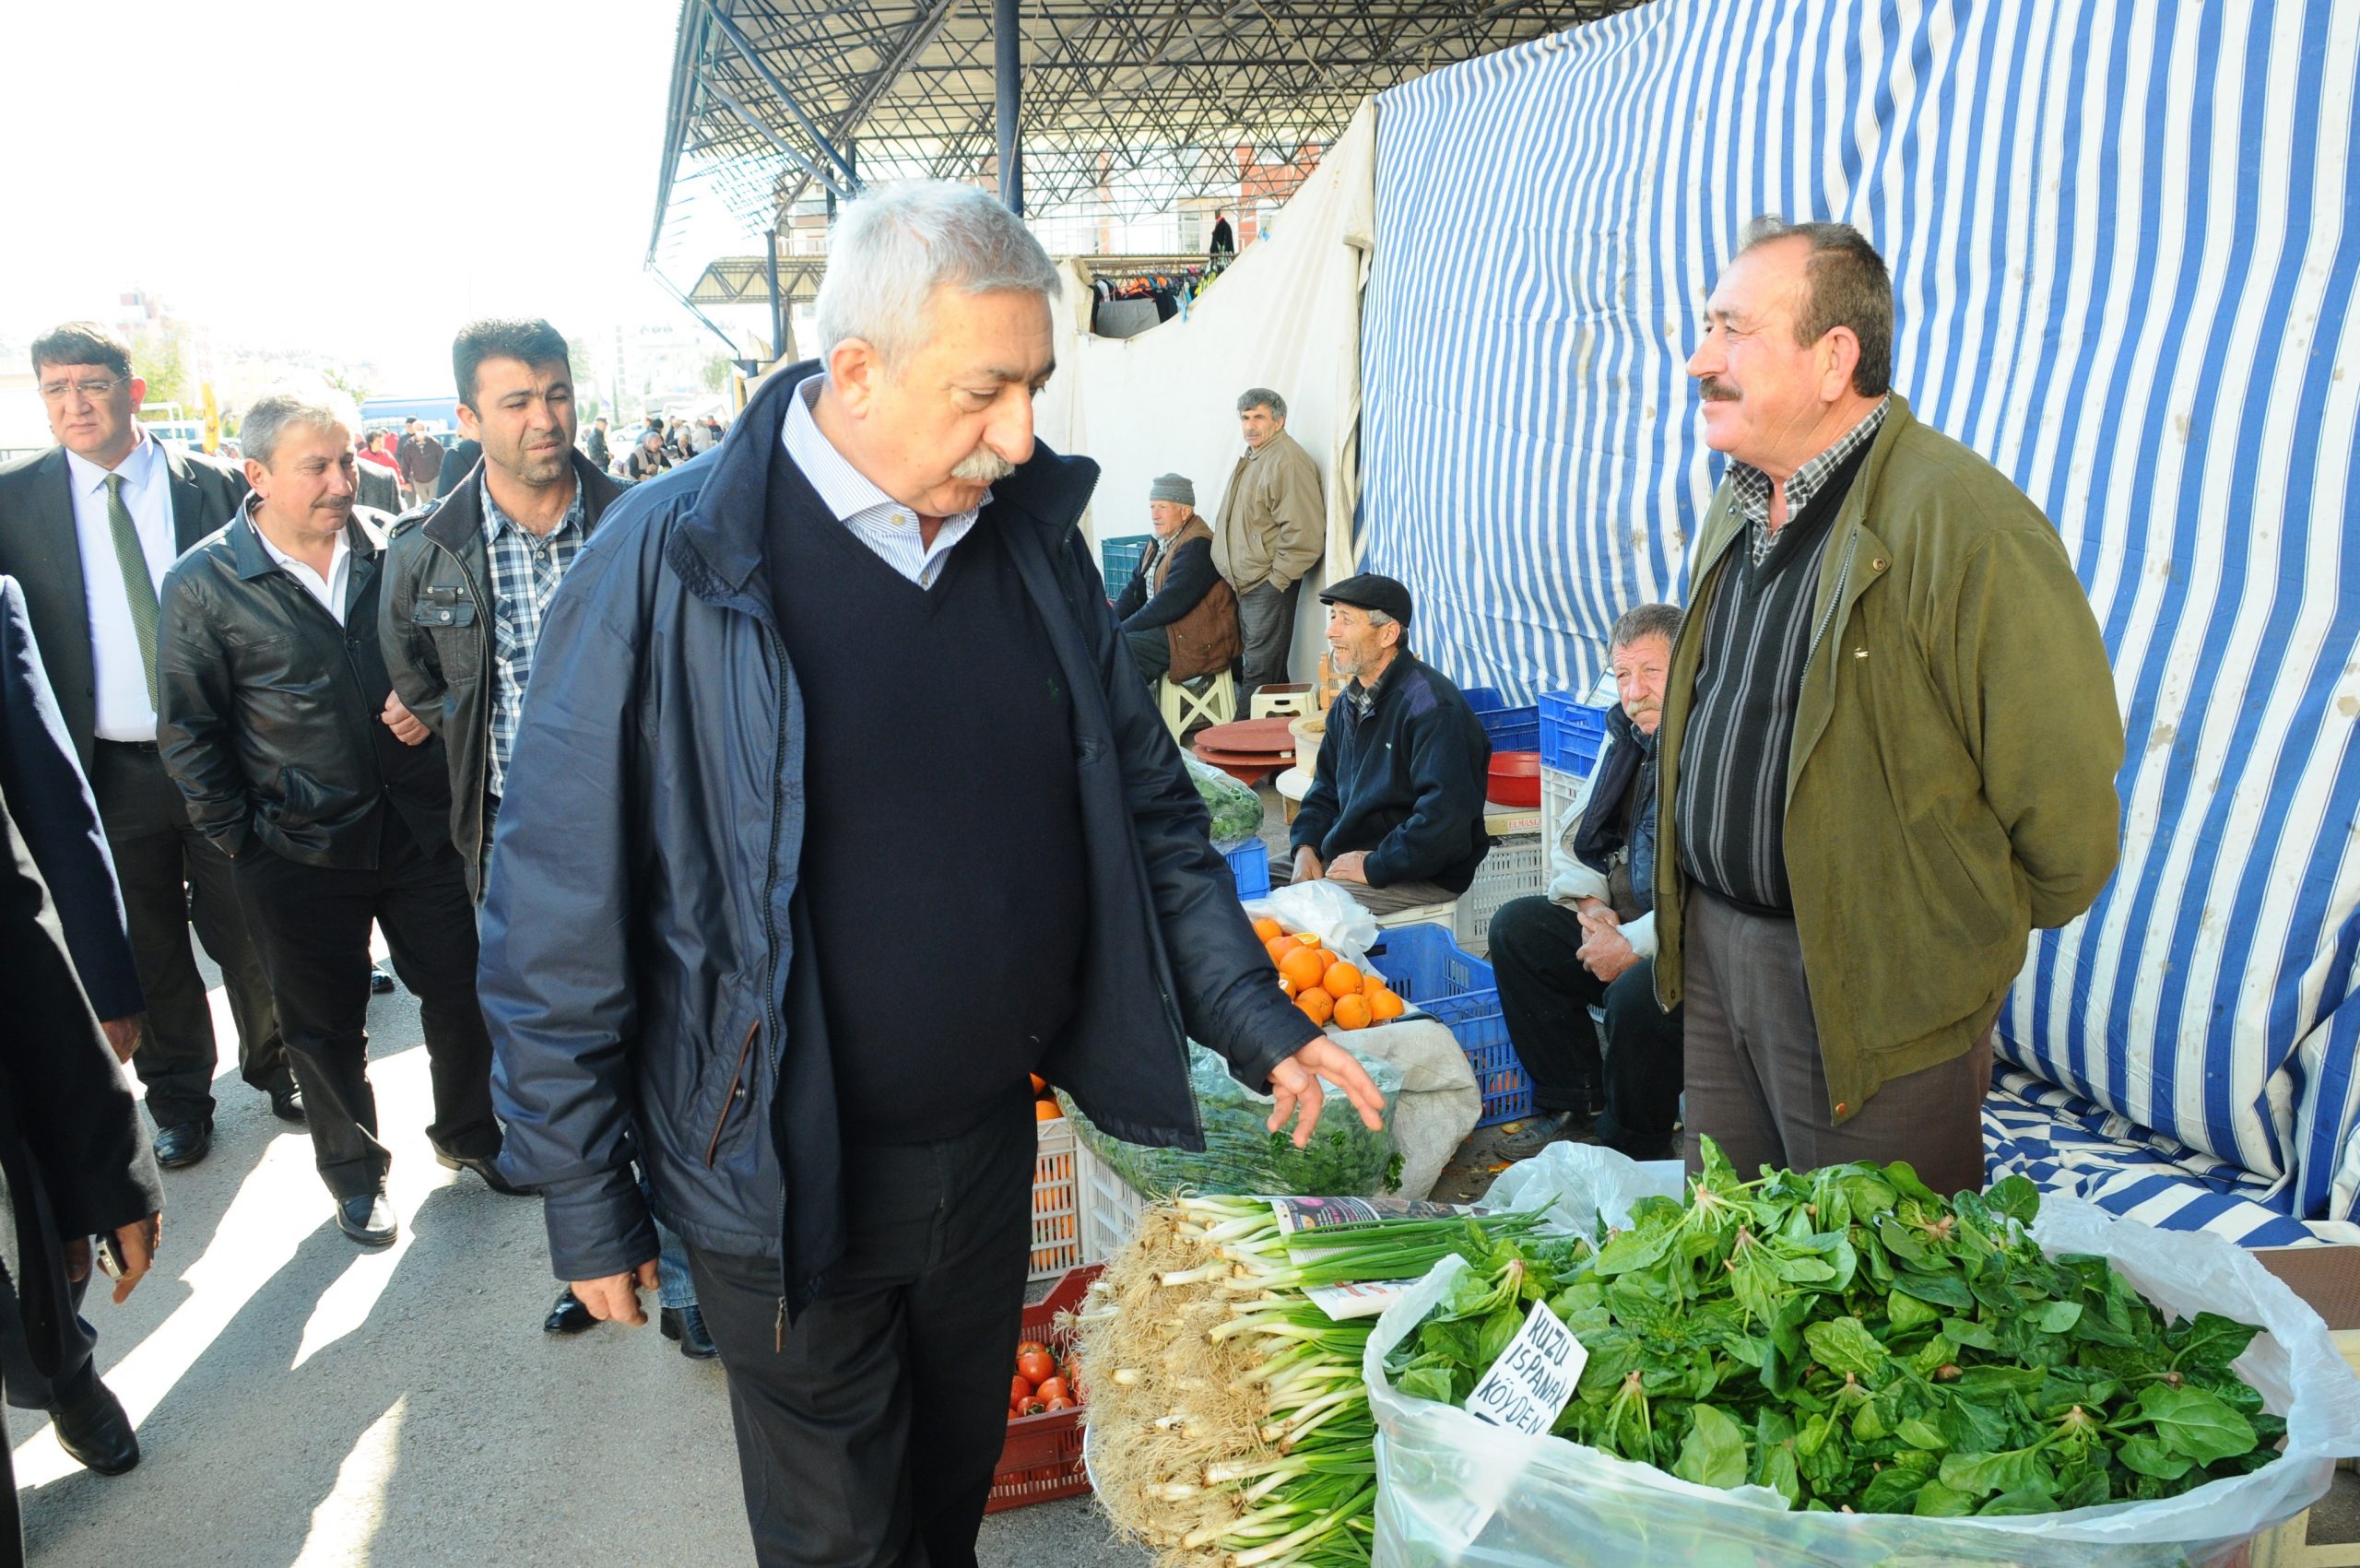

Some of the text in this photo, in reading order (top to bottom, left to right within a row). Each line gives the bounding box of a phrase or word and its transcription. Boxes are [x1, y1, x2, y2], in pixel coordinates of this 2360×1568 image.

[1528, 1308, 1570, 1367] KUZU
[1477, 1372, 1546, 1435] KÖYDEN
[1504, 1342, 1569, 1416] ISPANAK
